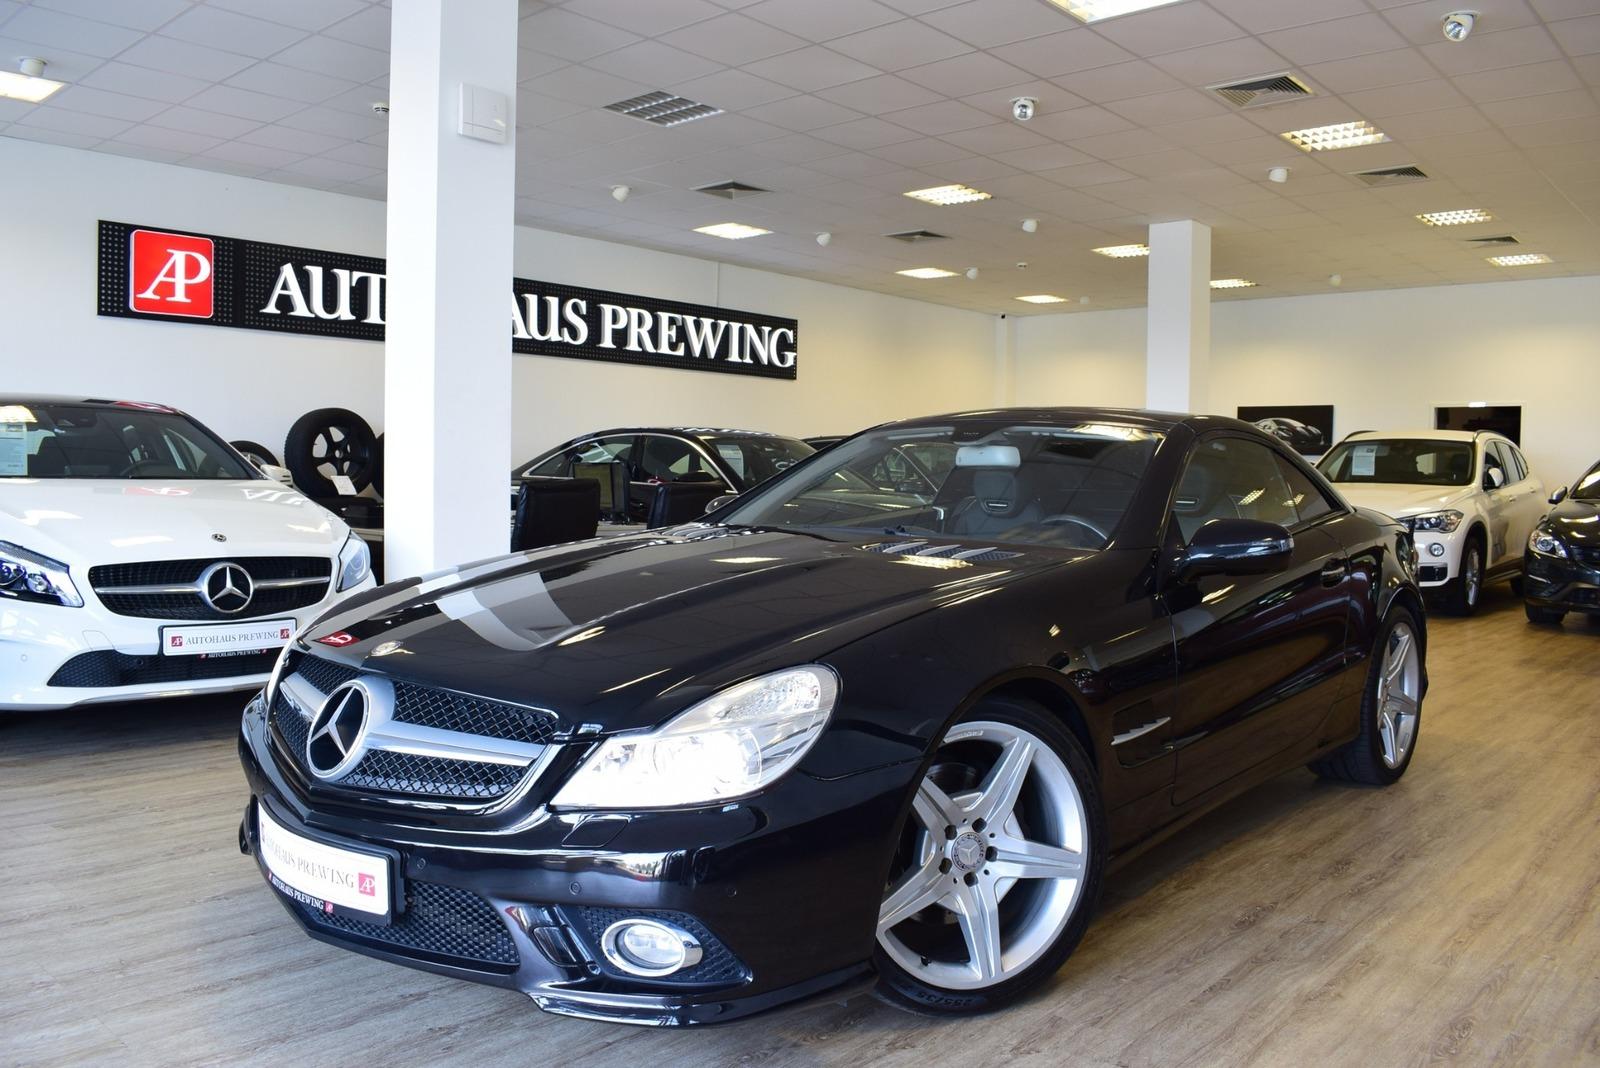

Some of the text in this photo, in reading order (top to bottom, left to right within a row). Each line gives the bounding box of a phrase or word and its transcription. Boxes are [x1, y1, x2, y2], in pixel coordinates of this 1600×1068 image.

[137, 248, 210, 303] AP
[597, 303, 797, 368] PREWING
[186, 634, 236, 645] AUTOHAUS
[238, 631, 279, 641] PREWING
[297, 857, 354, 889] PREWING
[359, 876, 375, 894] AP
[293, 890, 324, 910] PREWING
